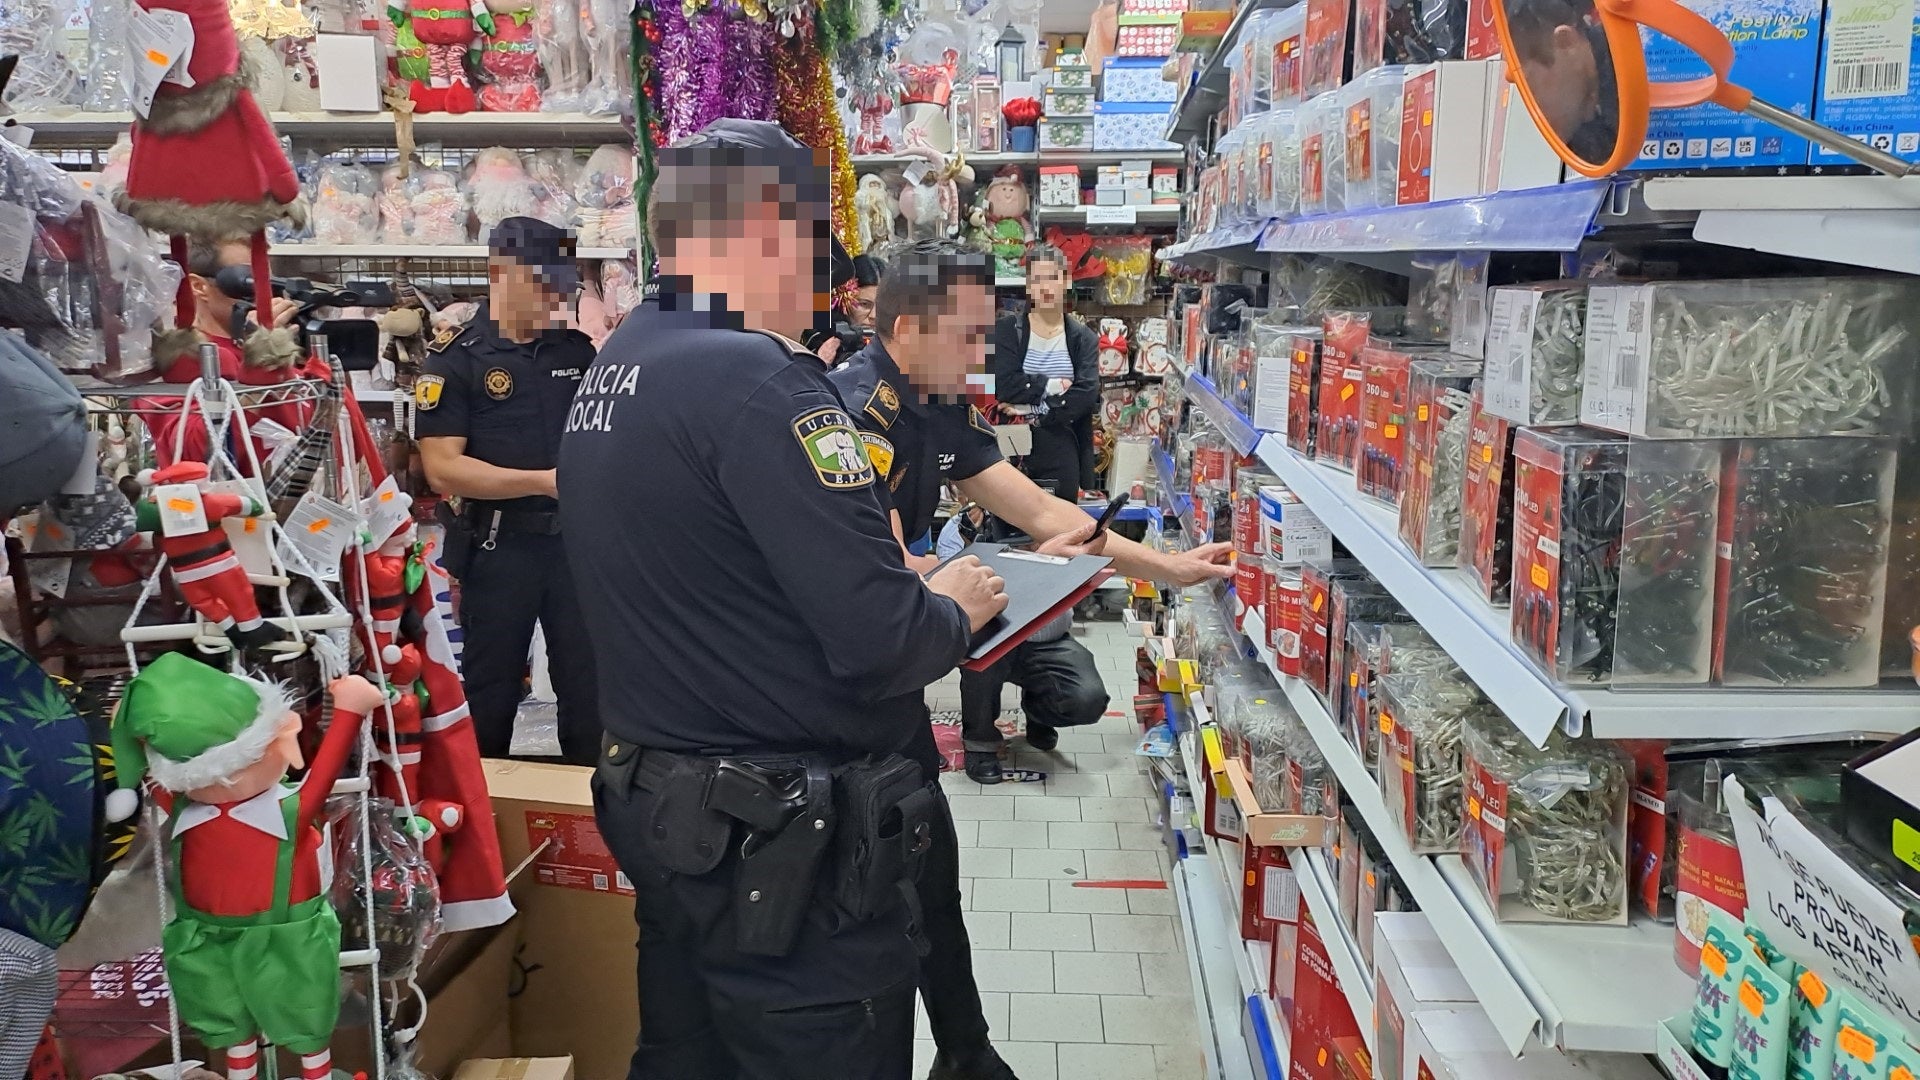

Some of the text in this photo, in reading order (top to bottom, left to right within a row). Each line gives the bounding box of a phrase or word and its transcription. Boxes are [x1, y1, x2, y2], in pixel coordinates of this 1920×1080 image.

[1731, 13, 1811, 29] Festival
[1761, 26, 1809, 42] Lamp
[1853, 124, 1863, 132] in
[1865, 123, 1894, 131] China
[551, 367, 580, 378] POLICIA
[1366, 382, 1380, 396] 360
[1714, 885, 1745, 900] NAVIDAD
[1792, 879, 1888, 978] PROBAR
[1301, 943, 1329, 971] CORTINA
[1767, 890, 1920, 1024] LOS ARTICUL
